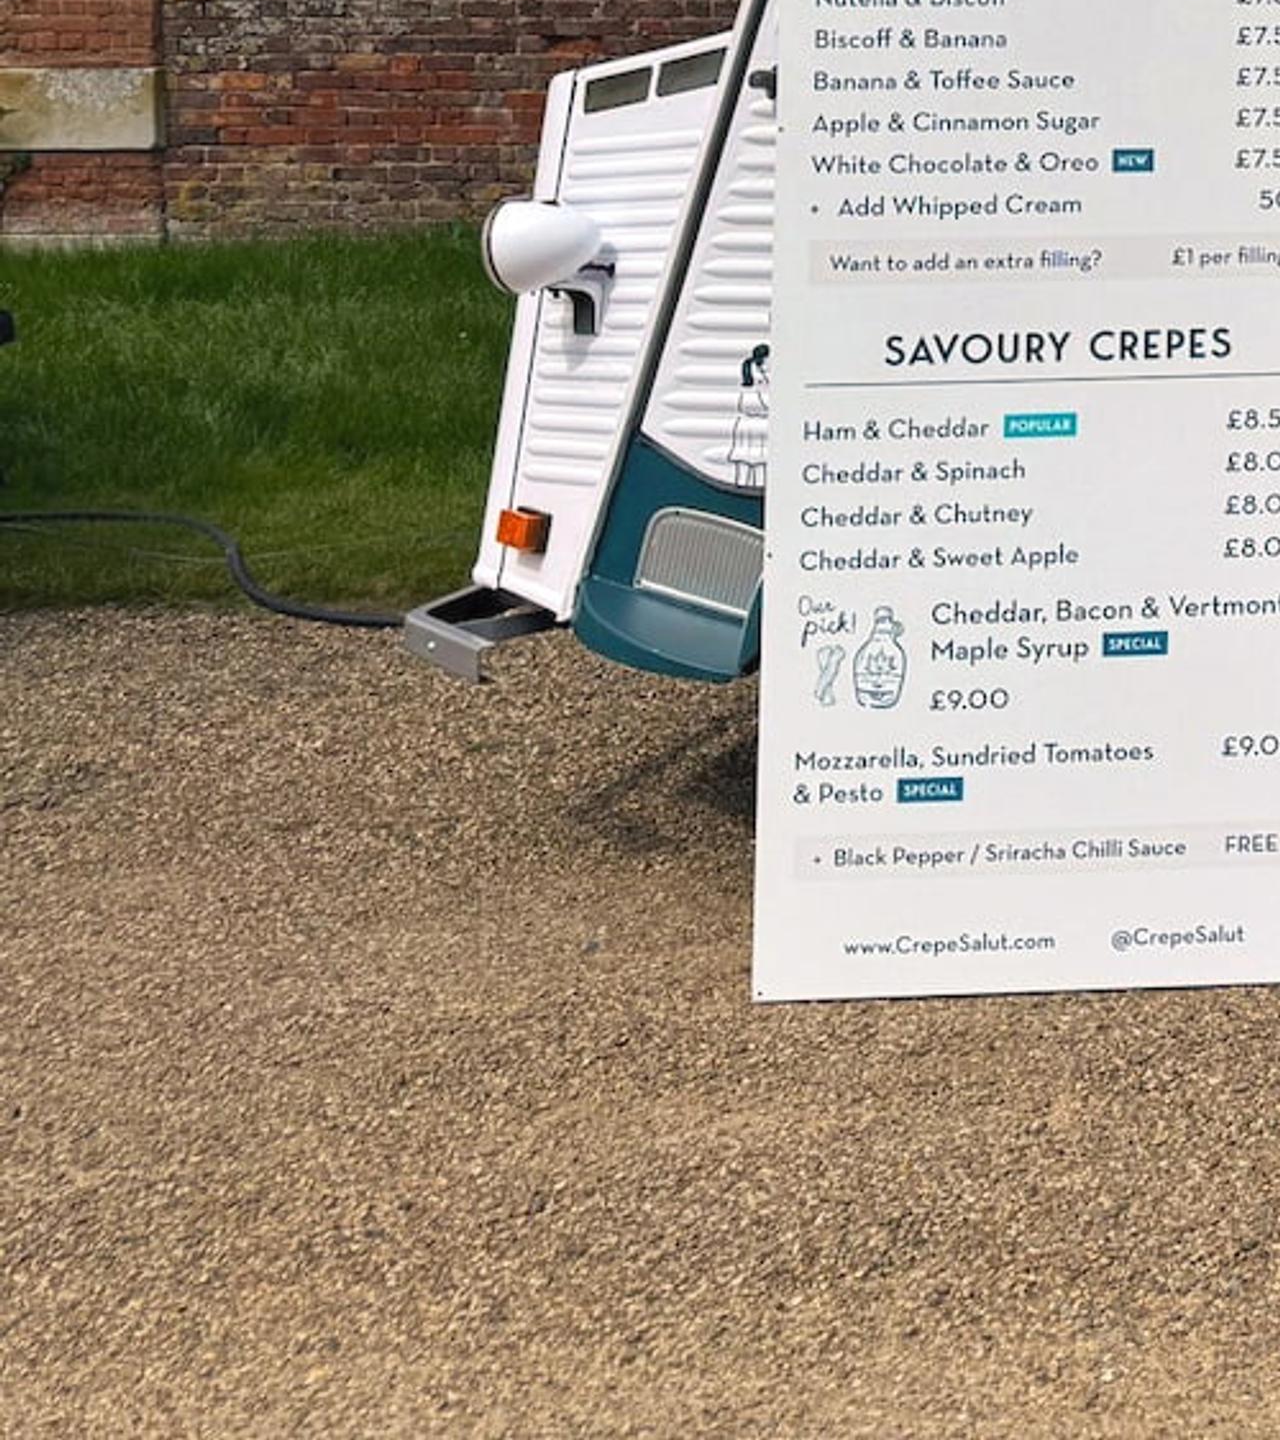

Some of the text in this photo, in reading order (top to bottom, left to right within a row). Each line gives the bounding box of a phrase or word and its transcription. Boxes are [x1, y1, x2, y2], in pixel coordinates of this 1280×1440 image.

[814, 26, 893, 49] Biscoff
[898, 28, 916, 49] &
[924, 28, 1008, 49] Banana
[813, 70, 898, 91] Banana
[903, 69, 921, 91] &
[929, 68, 1000, 90] Toffee
[1007, 69, 1075, 90] Sauce
[812, 112, 881, 138] Apple
[887, 111, 905, 133] &
[912, 111, 1029, 132] Cinnamon
[1036, 110, 1101, 136] Sugar
[811, 154, 882, 175] White
[888, 152, 1008, 175] Chocolate
[1014, 151, 1031, 172] &
[1038, 151, 1100, 172] Oreo
[1118, 154, 1148, 167] NEW
[838, 195, 885, 217] Add
[892, 193, 998, 221] Whipped
[1005, 192, 1082, 215] Cream
[829, 255, 881, 272] Want
[887, 255, 908, 272] to
[912, 252, 950, 272] add
[954, 257, 978, 270] an
[983, 252, 1034, 270] extra
[1039, 249, 1103, 273] filling?
[1171, 246, 1194, 266] £1
[1199, 252, 1232, 269] per
[885, 327, 1232, 367] SAVOURY CREPES
[803, 420, 857, 441] Ham
[862, 420, 881, 441] &
[887, 415, 990, 440] Cheddar
[1009, 418, 1071, 433] POPULAR
[801, 460, 904, 485] Cheddar
[910, 461, 928, 482] &
[935, 457, 1026, 486] Spinach
[800, 505, 903, 528] Cheddar
[909, 504, 927, 525] &
[933, 501, 1033, 528] Chutney
[799, 547, 902, 572] Cheddar
[907, 547, 926, 569] &
[932, 546, 1003, 568] Sweet
[1010, 541, 1079, 571] Apple
[931, 599, 1047, 626] Cheddar,
[1056, 599, 1133, 622] Bacon
[1141, 595, 1159, 619] &
[931, 635, 1162, 668] Maple Syrup SPECIAL
[929, 687, 1010, 712] £9.00
[794, 746, 925, 771] Mozzarella,
[931, 741, 1037, 768] Sundried
[1043, 742, 1155, 764] Tomatoes
[792, 782, 957, 805] & Pesto SPECIAL
[833, 833, 1278, 869] Black Pepper / Sriracha Chilli Sauce FREE
[844, 932, 1056, 958] www.CrepeSalut.com
[1111, 924, 1245, 952] @CrepeSalut
